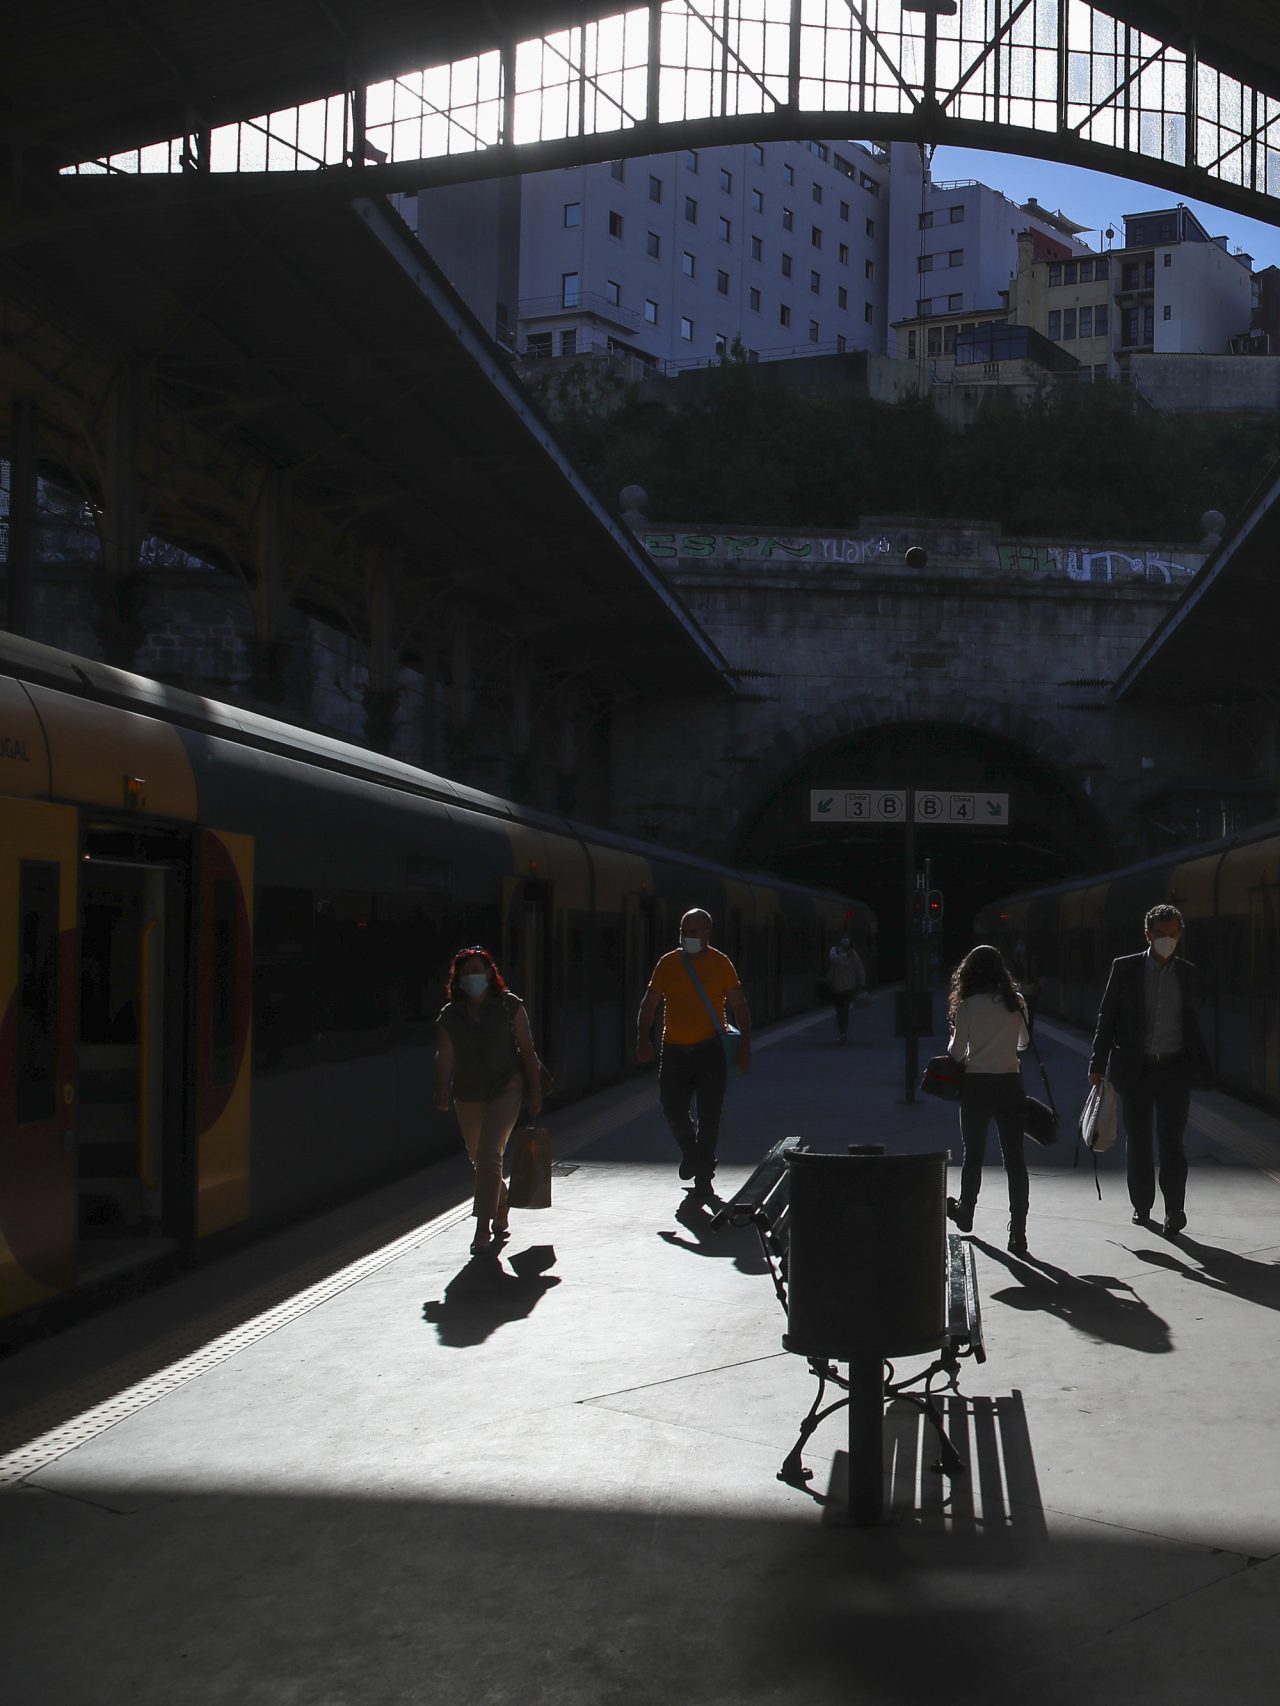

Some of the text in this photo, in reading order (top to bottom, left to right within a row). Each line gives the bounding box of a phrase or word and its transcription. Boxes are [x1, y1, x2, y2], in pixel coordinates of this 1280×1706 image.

[853, 798, 897, 817] 3 B
[924, 799, 968, 818] B 4
